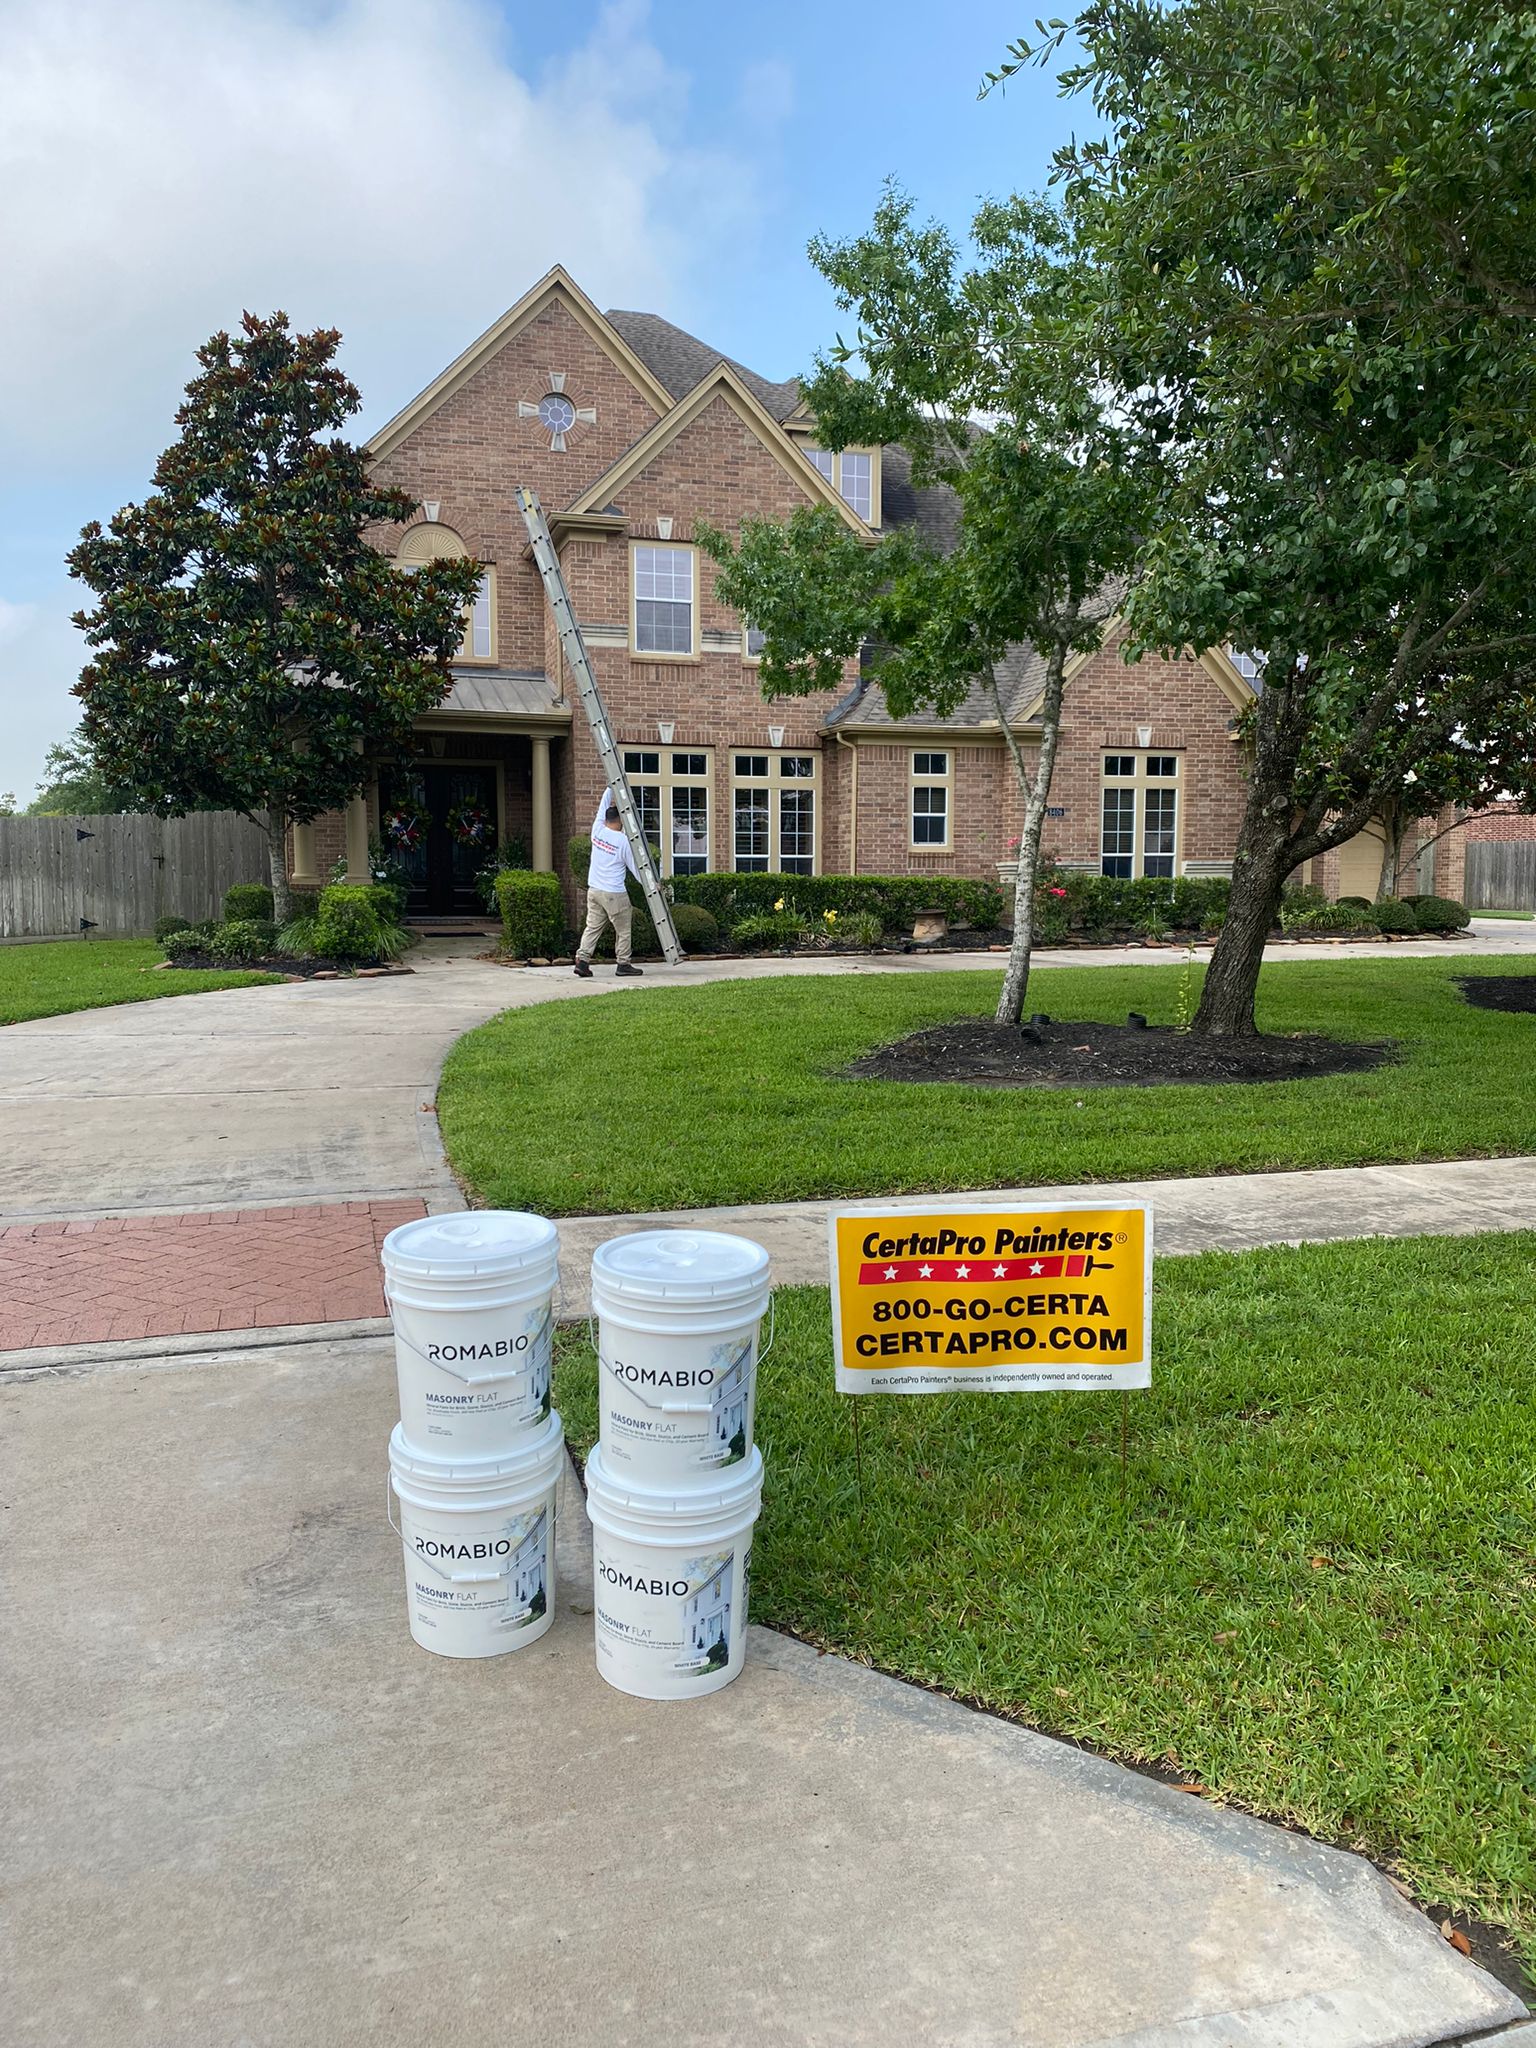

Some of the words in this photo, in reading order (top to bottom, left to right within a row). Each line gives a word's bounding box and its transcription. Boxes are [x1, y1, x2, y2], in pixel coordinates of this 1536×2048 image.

[862, 1228, 986, 1258] CertaPro
[872, 1293, 1110, 1322] 800-GO-CERTA
[428, 1335, 528, 1361] ROMABIO
[855, 1326, 1128, 1357] CERTAPRO.COM
[615, 1361, 714, 1387] ROMABIO
[871, 1377, 888, 1385] Each
[889, 1375, 919, 1385] CertaPro
[953, 1375, 984, 1383] business
[985, 1374, 991, 1382] is
[993, 1373, 1040, 1383] independently
[1066, 1372, 1080, 1380] and
[426, 1393, 474, 1404] MASONRY
[477, 1392, 498, 1402] FLAT
[611, 1410, 652, 1431] MASONRY
[655, 1423, 677, 1433] FLAT
[415, 1537, 510, 1559] ROMABIO
[415, 1582, 454, 1600] MASONRY
[456, 1592, 477, 1601] FLAT
[599, 1560, 689, 1597] ROMABIO
[598, 1607, 630, 1633] MASONRY
[632, 1626, 652, 1638] FLAT
